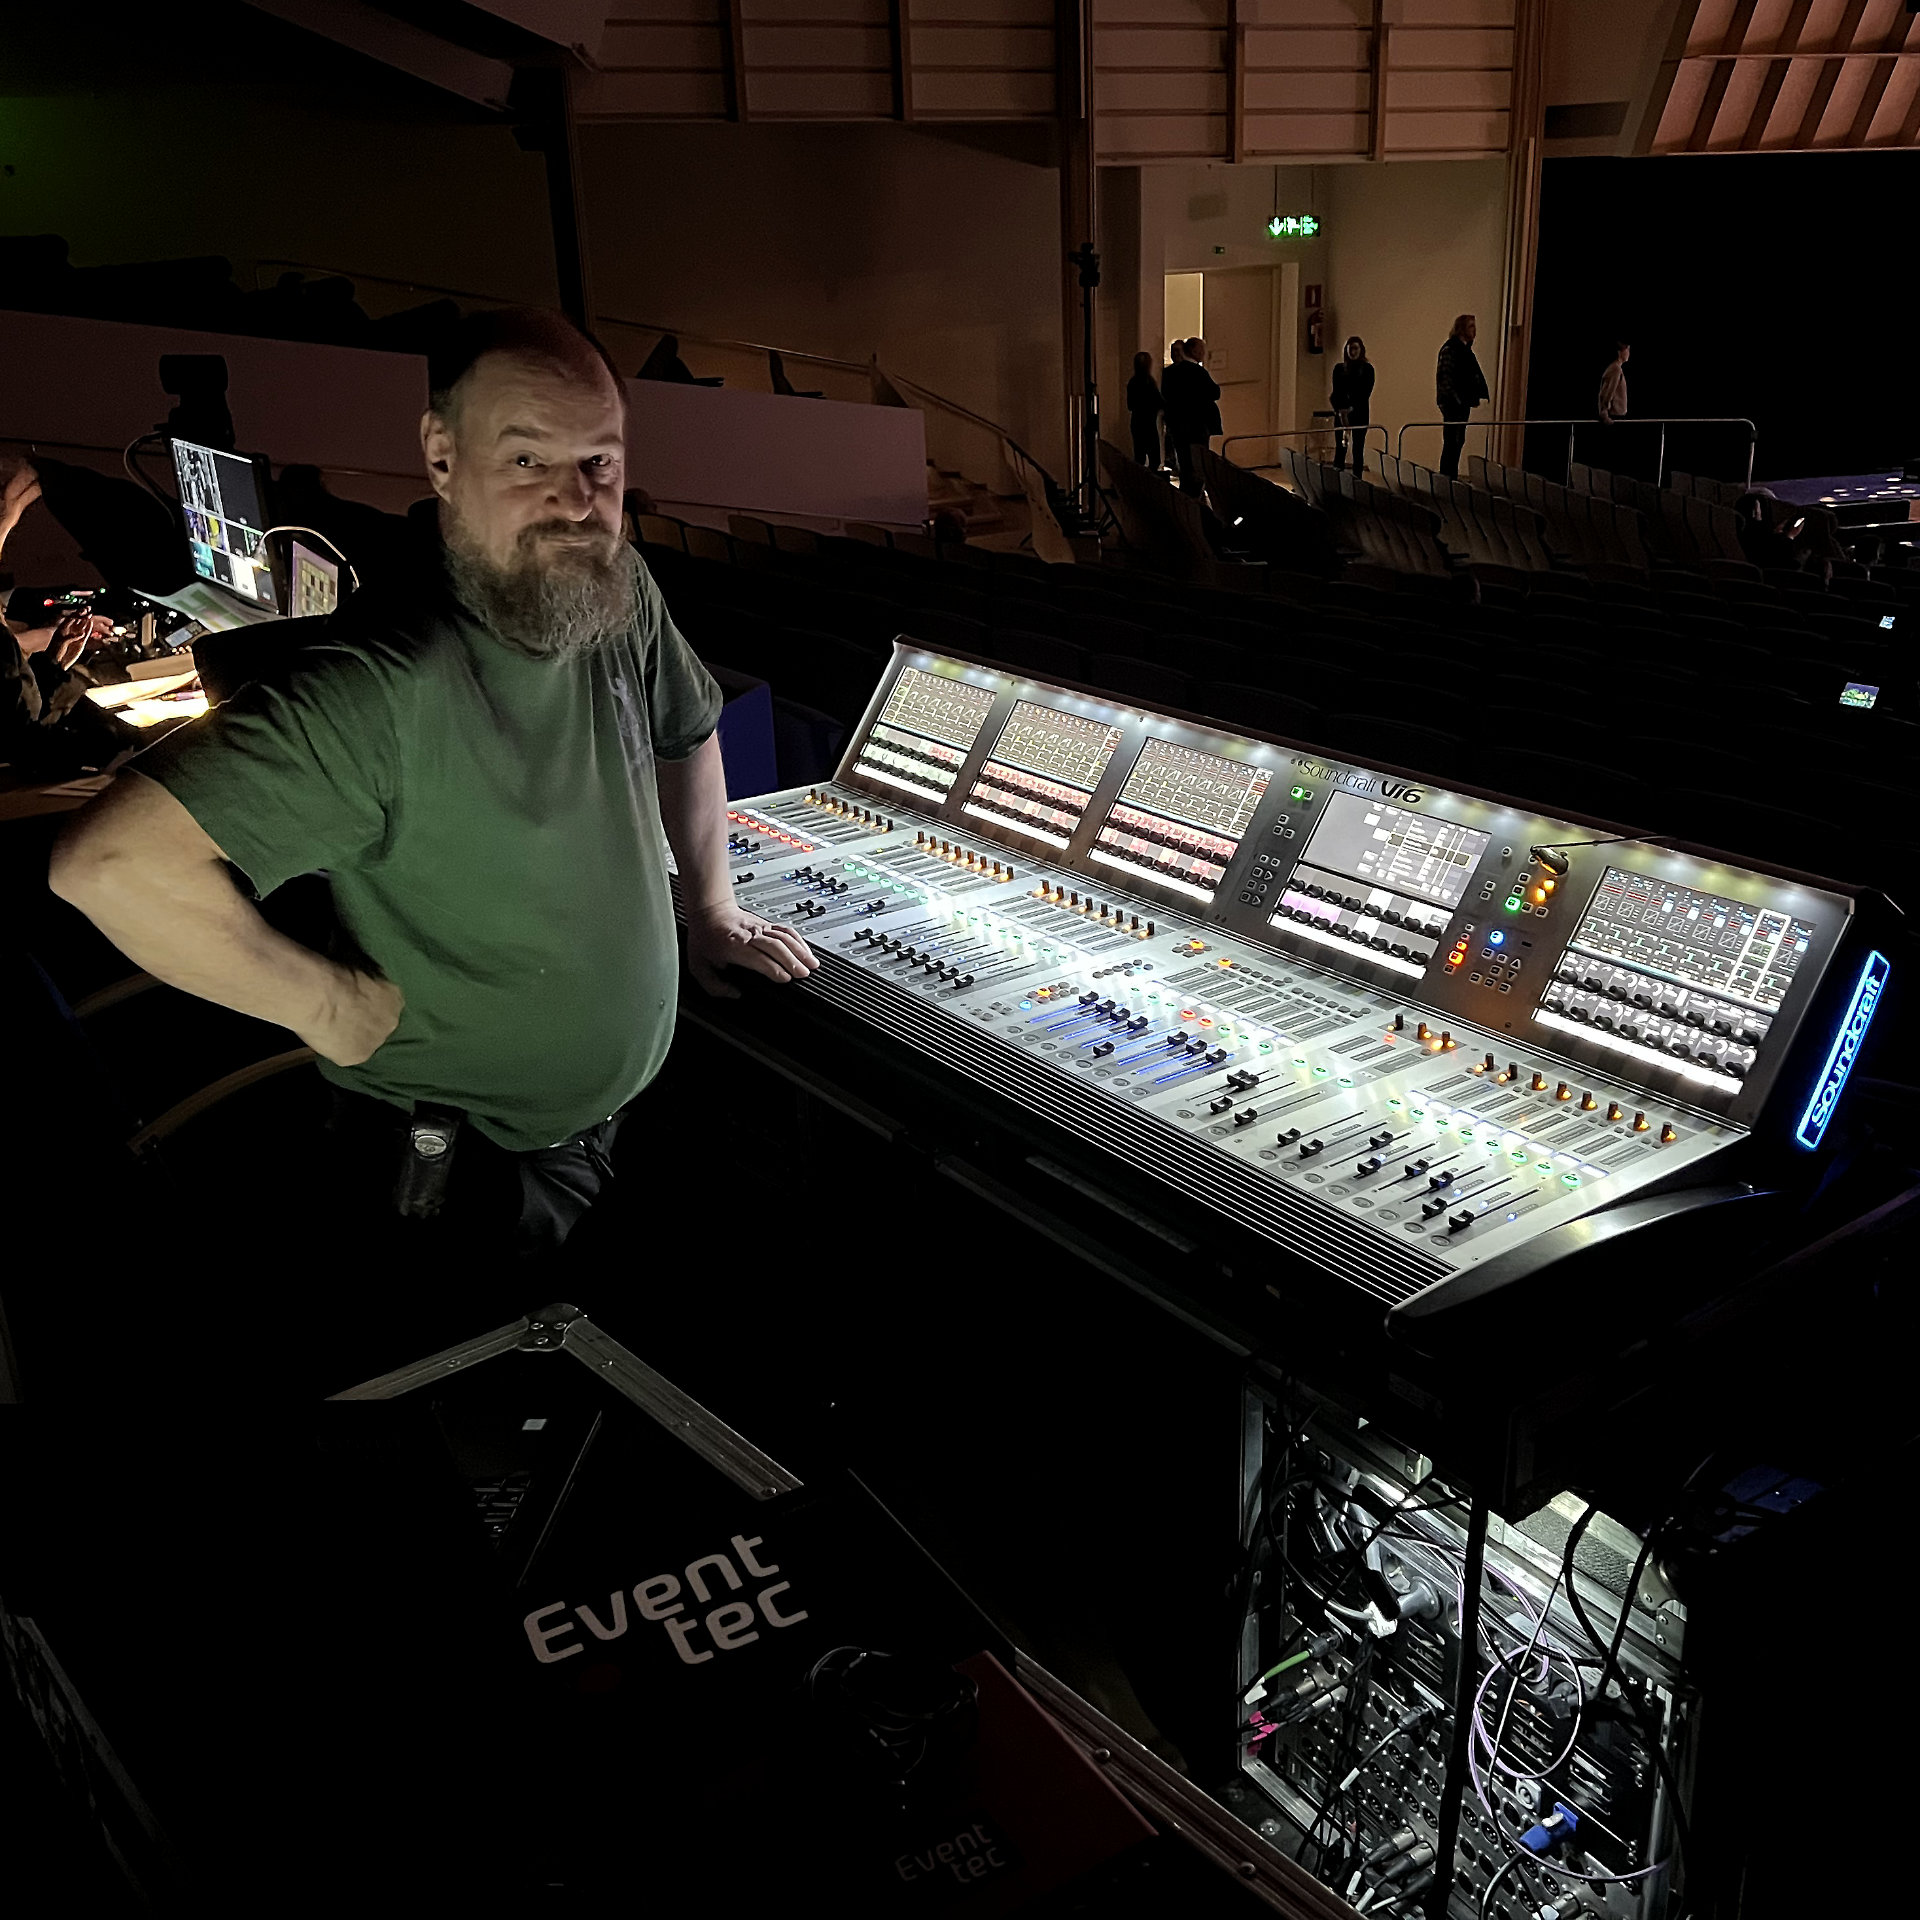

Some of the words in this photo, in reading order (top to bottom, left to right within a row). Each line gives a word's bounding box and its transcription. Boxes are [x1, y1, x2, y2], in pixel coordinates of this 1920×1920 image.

[1299, 760, 1377, 793] Soundcraft
[1380, 780, 1425, 804] Vi6
[1811, 974, 1881, 1128] Soundcraft
[523, 1533, 780, 1664] Event
[663, 1580, 809, 1665] tec
[894, 1823, 993, 1882] Event
[950, 1846, 1006, 1884] tec
